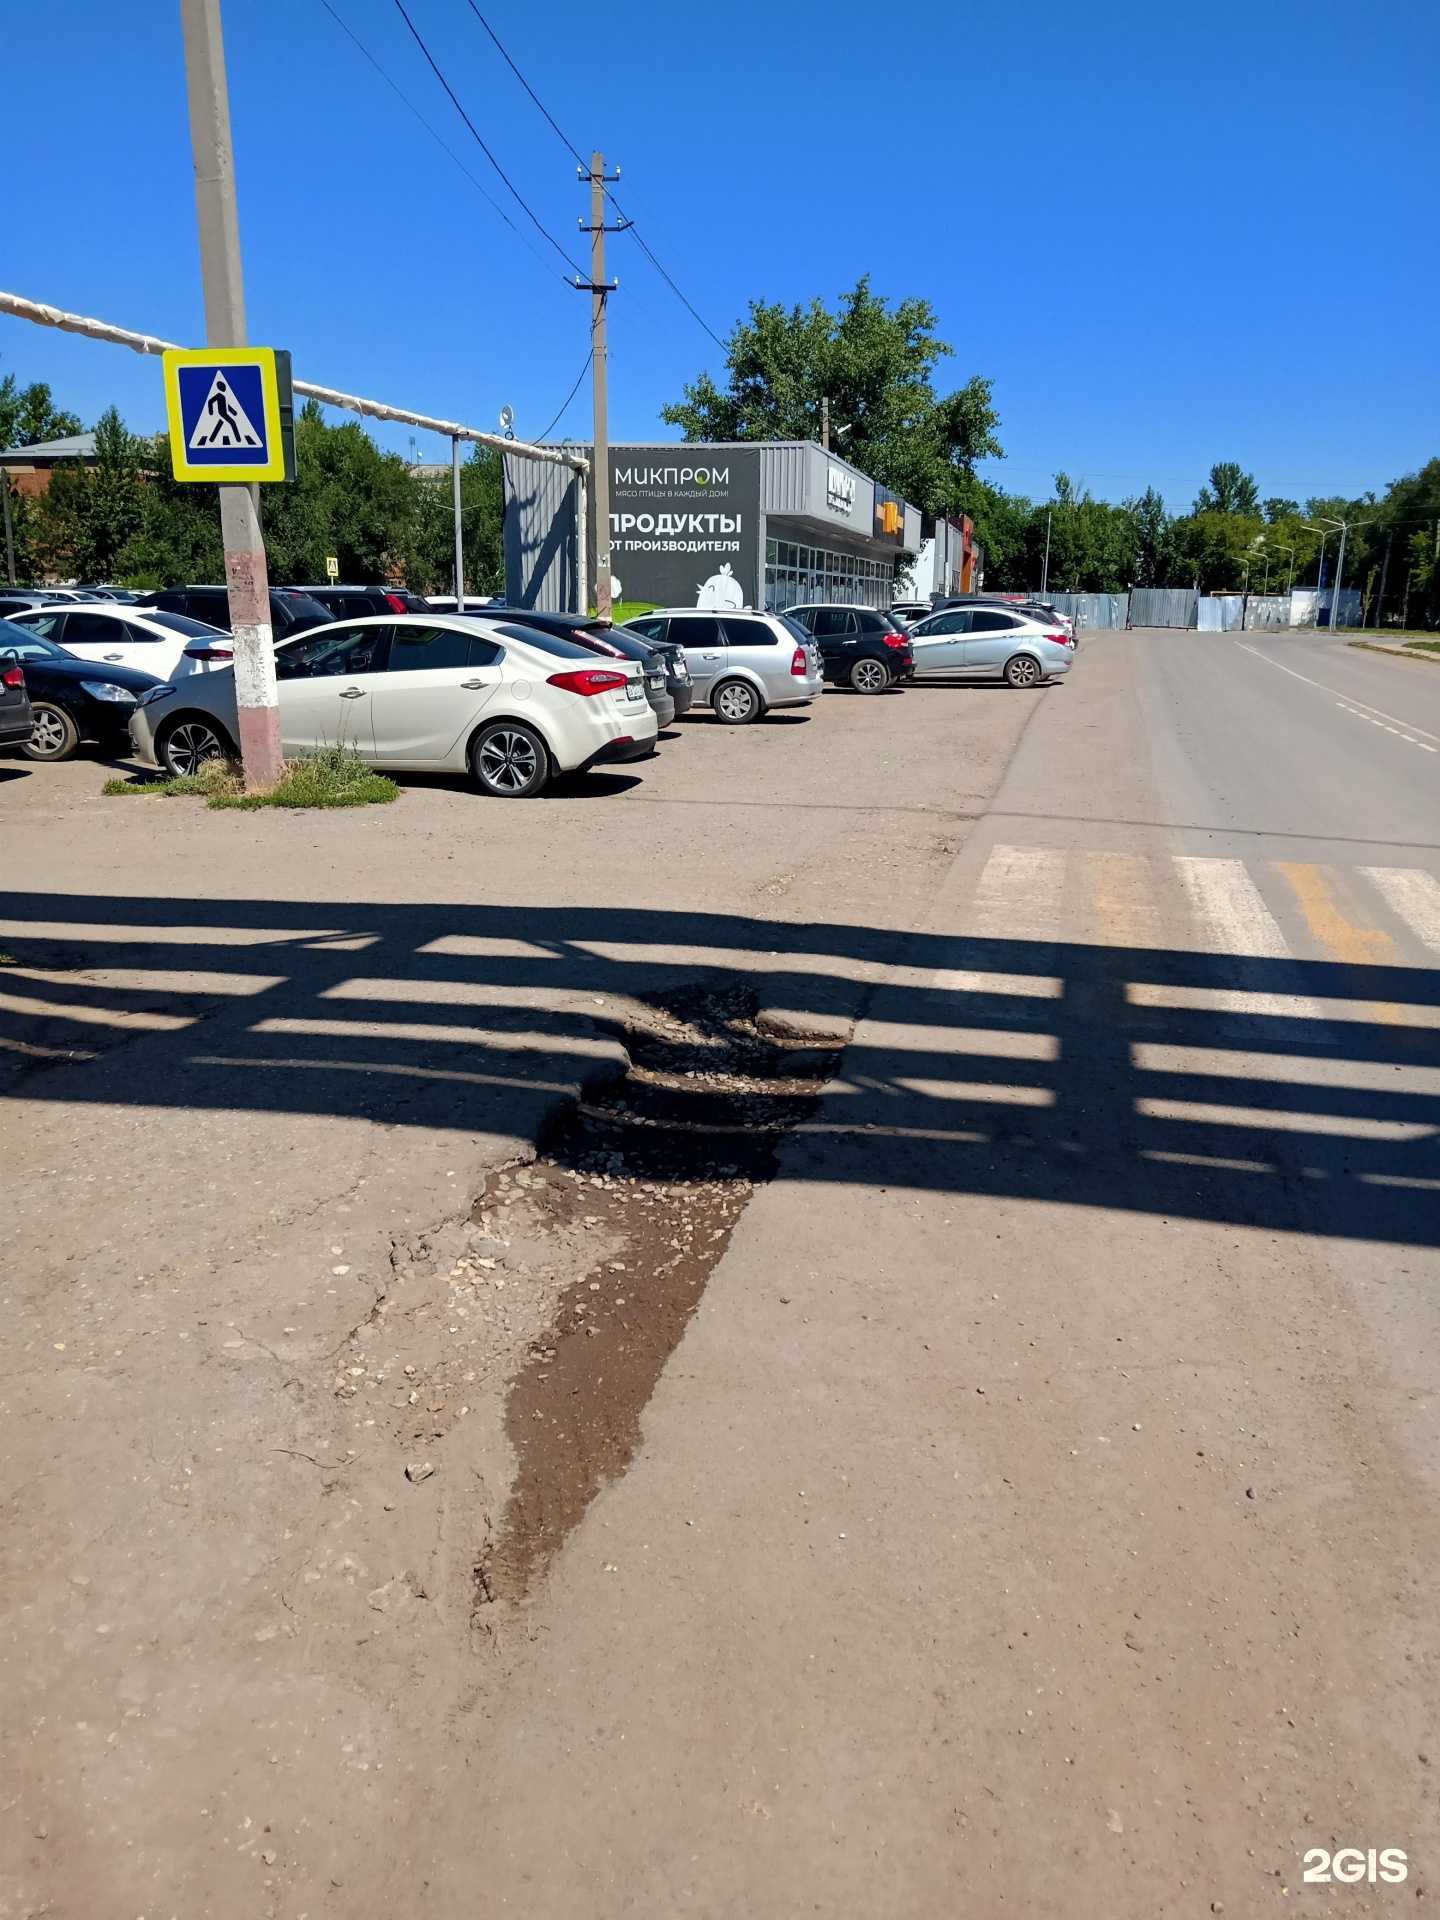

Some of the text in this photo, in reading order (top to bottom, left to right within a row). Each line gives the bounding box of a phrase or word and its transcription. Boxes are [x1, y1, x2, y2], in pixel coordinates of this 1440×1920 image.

[615, 490, 638, 498] МЯСО
[639, 490, 666, 498] ПТИЦЫ
[674, 489, 708, 498] КАЖДЫЙ
[708, 490, 729, 498] ДОМ!
[608, 513, 742, 536] ПРОДУКТЫ
[625, 540, 740, 553] ПРОИЗВОДИТЕЛЯ
